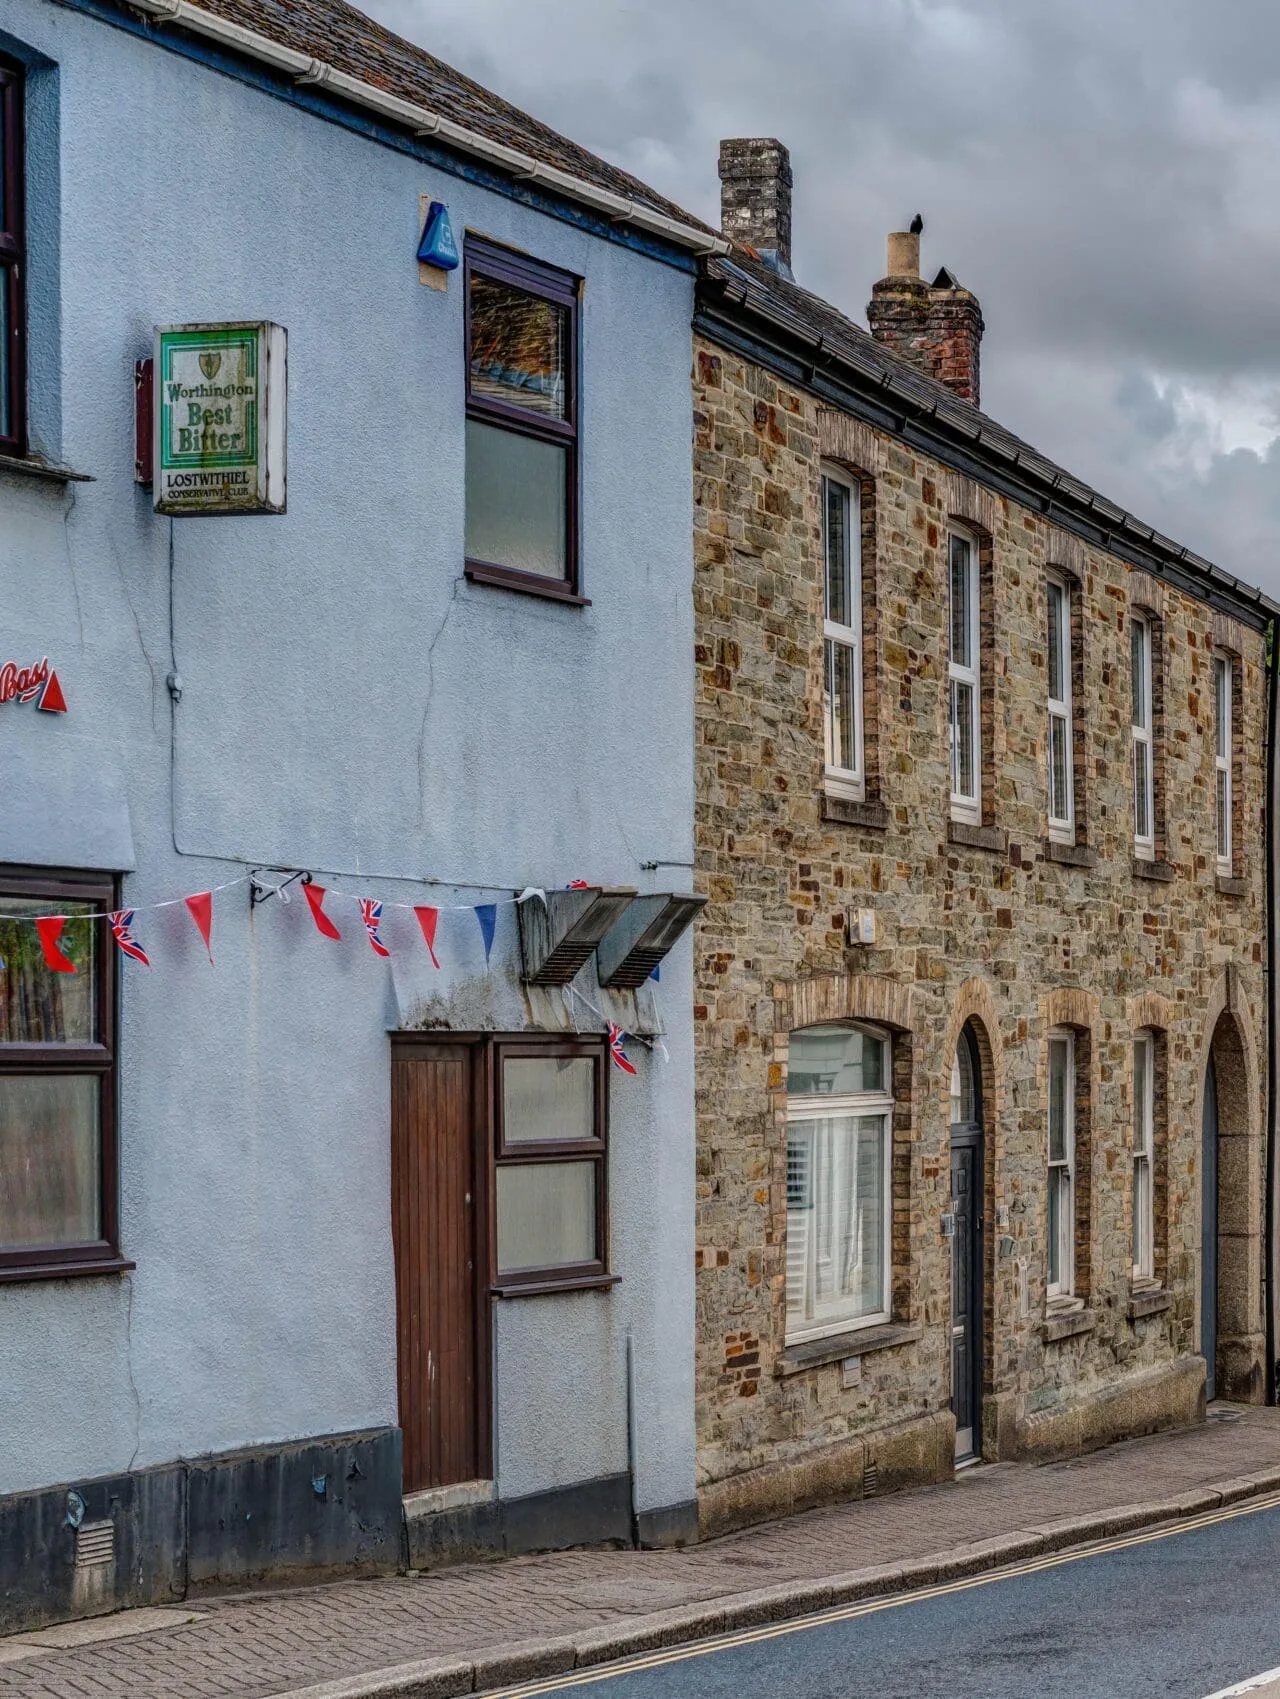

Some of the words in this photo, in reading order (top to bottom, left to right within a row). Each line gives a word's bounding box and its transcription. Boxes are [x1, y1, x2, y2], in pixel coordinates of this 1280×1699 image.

[167, 382, 254, 402] Worthington
[187, 402, 233, 427] Best
[178, 428, 243, 452] Bitter
[167, 471, 250, 488] LOSTWITHIEL
[168, 488, 225, 499] CONSERVATIVE
[228, 487, 249, 497] CLUB
[0, 655, 49, 704] Bass
